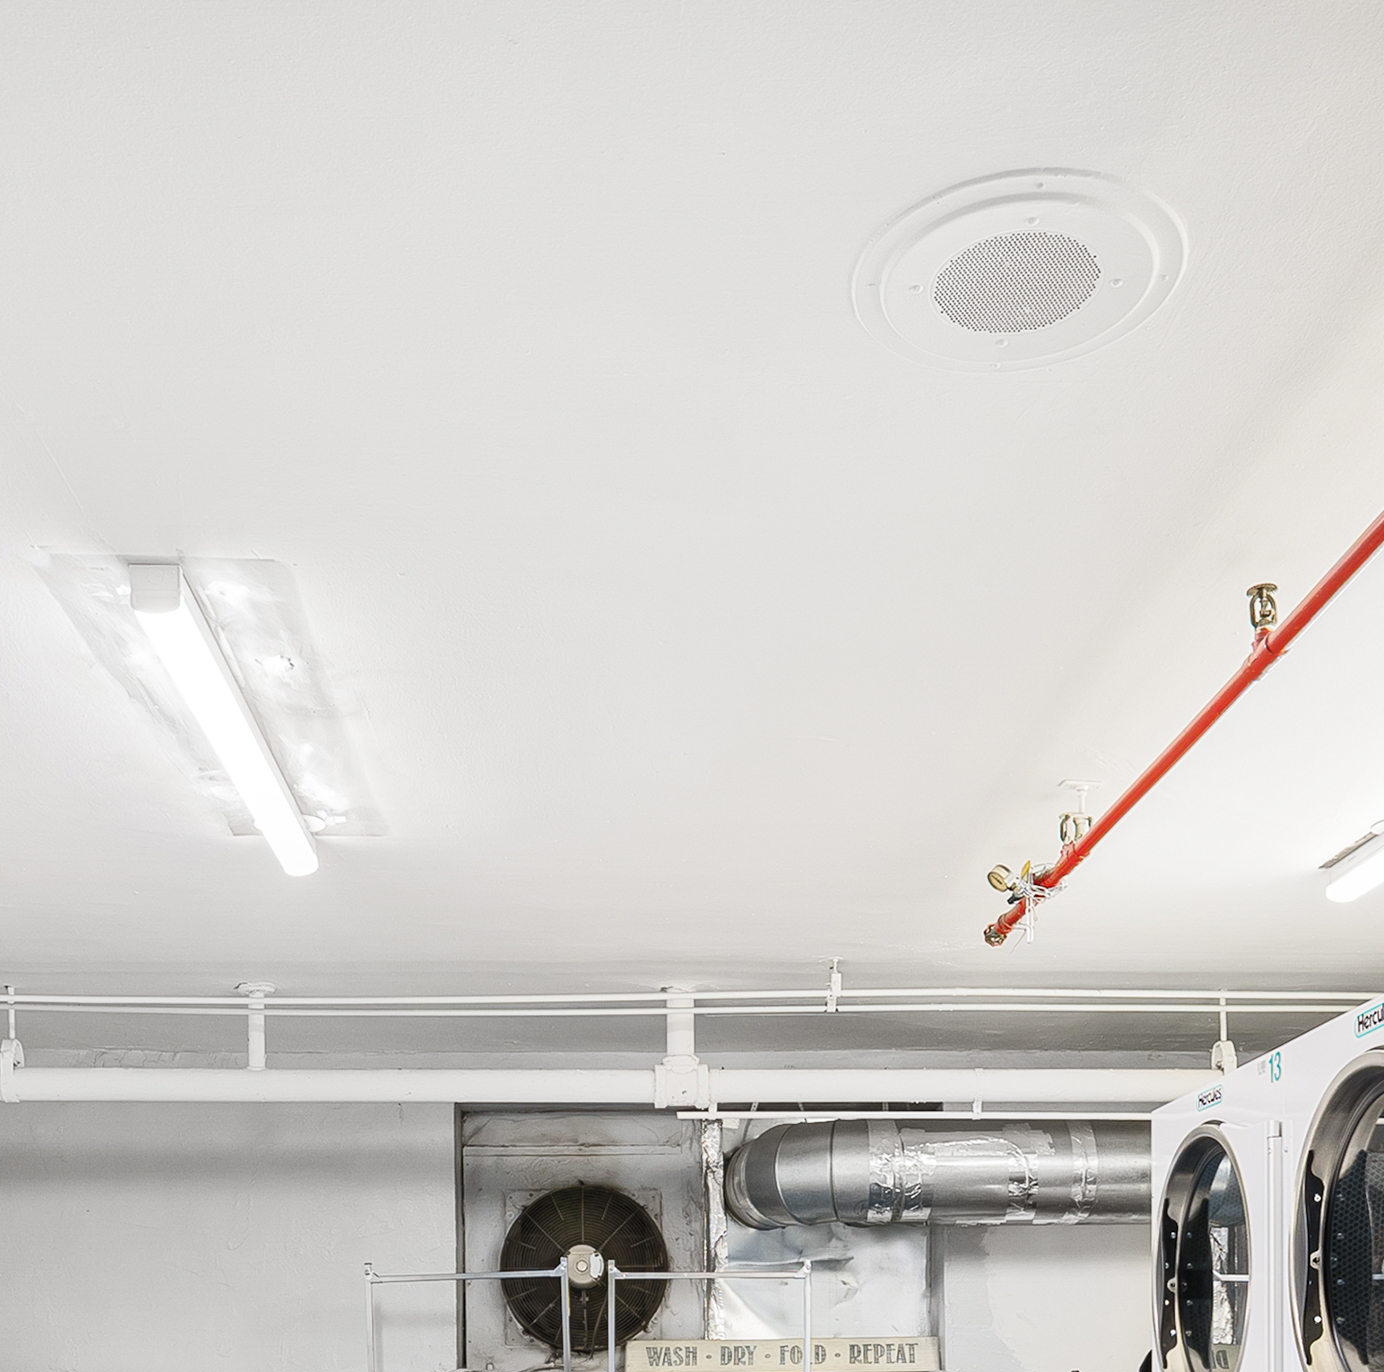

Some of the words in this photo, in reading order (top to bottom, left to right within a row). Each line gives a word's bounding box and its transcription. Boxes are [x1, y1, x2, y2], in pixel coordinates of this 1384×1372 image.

[1268, 1051, 1282, 1083] 13
[1198, 1086, 1222, 1108] Hercules
[645, 1346, 698, 1367] WASH
[720, 1344, 757, 1366] DRY
[778, 1344, 827, 1365] FOD
[849, 1343, 919, 1364] REPEAT
